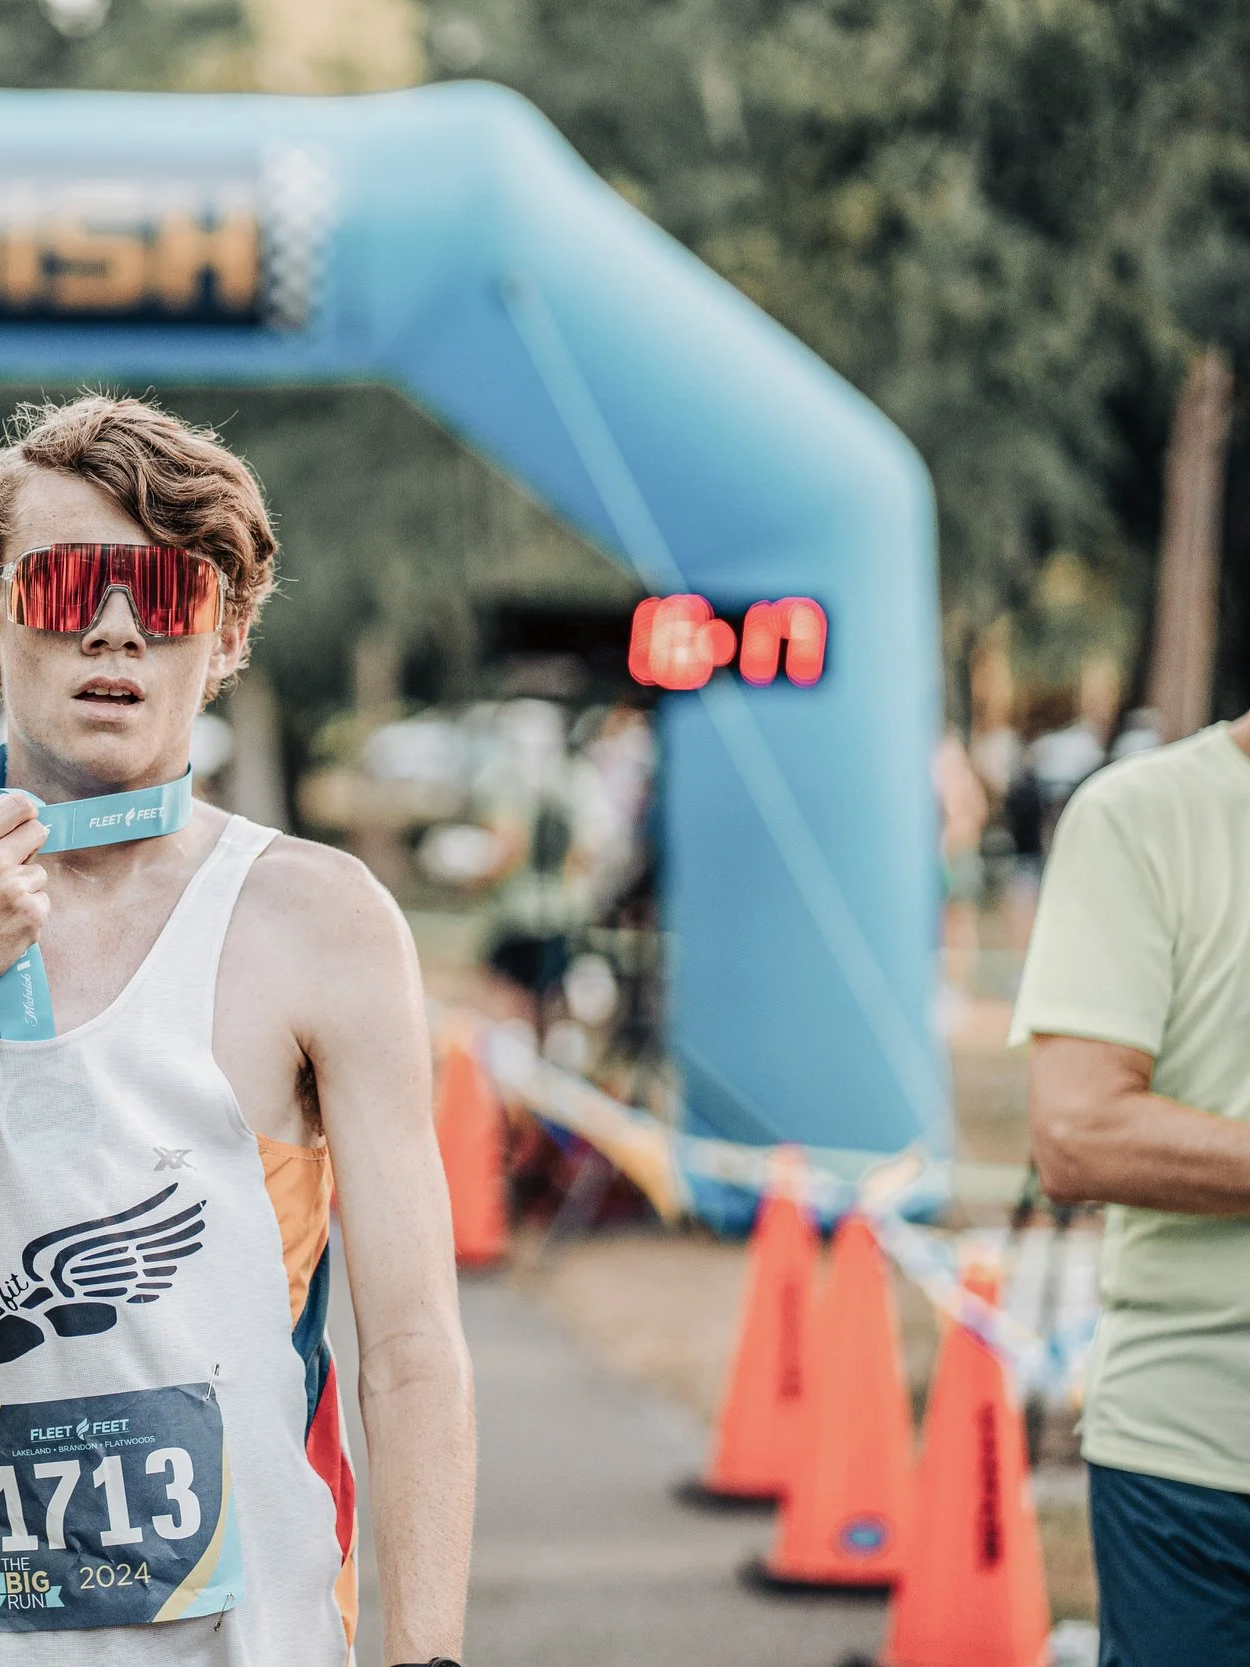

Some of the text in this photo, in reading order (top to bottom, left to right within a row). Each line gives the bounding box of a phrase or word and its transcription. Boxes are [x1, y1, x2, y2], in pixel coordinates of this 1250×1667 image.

[89, 806, 165, 828] FLEET FEET
[21, 973, 38, 1027] Michelob
[30, 1418, 130, 1441] FLEET FEET
[12, 1435, 156, 1457] LAKELAND BRANDON FLATWOODS
[0, 1556, 31, 1571] THE
[5, 1570, 51, 1594] BIG
[79, 1561, 151, 1590] 2024
[7, 1593, 46, 1610] RUN
